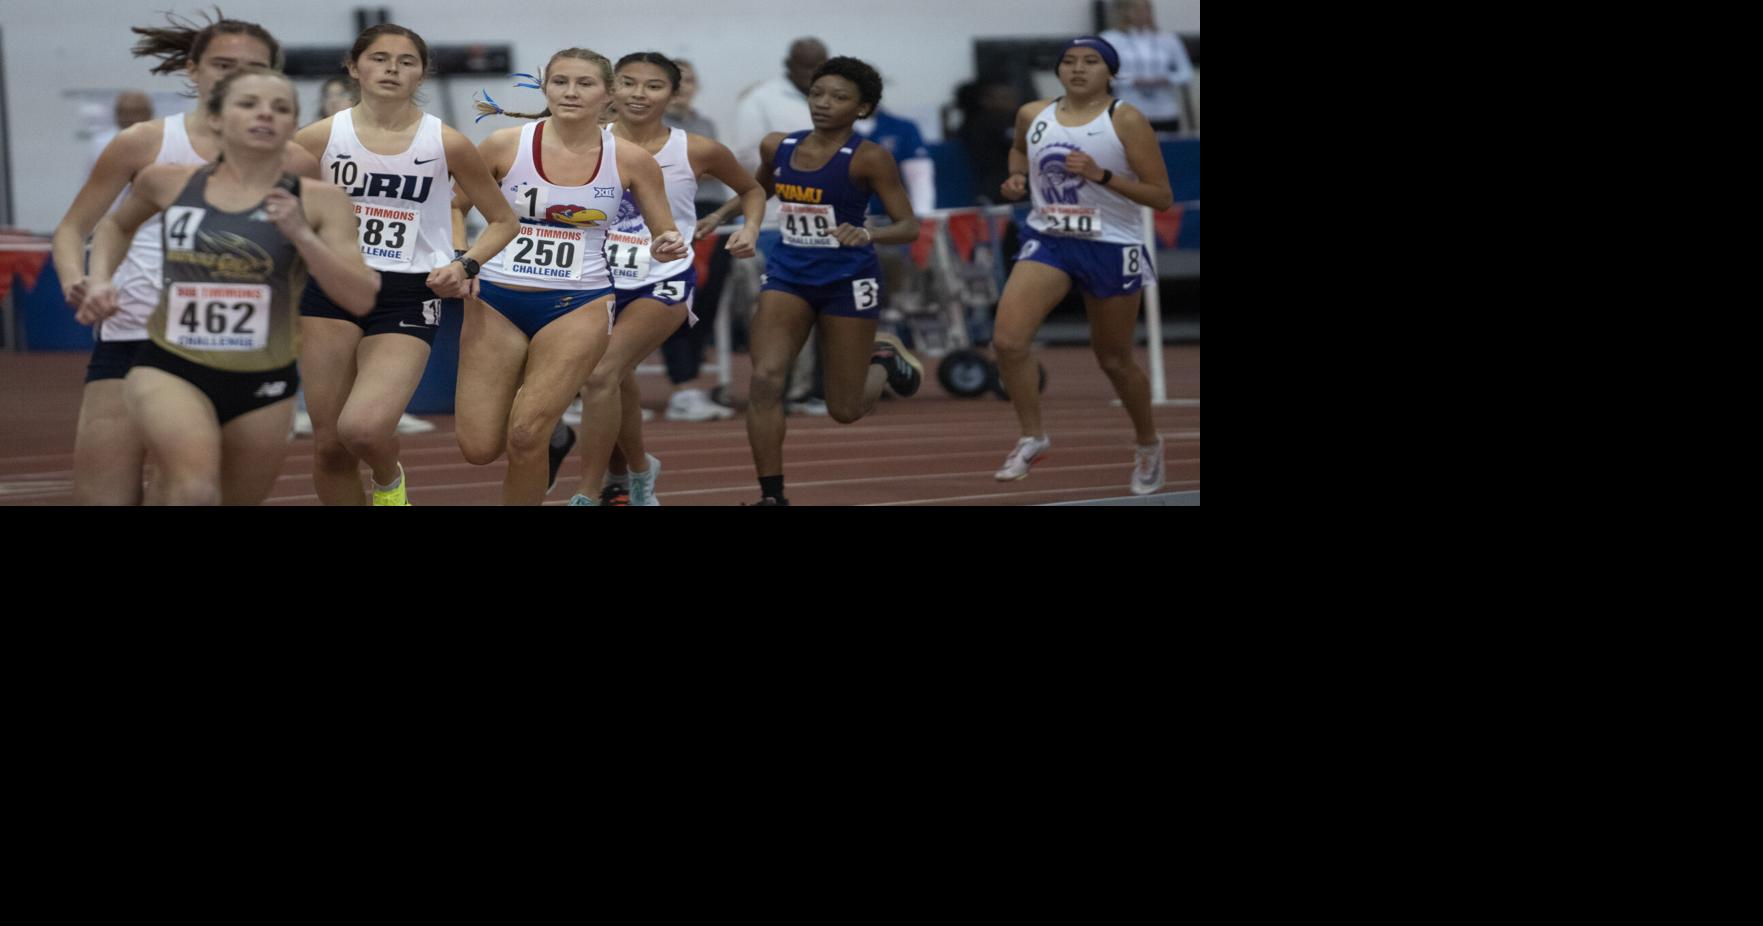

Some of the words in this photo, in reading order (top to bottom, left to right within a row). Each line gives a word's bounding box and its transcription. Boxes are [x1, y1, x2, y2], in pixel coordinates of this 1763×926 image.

[1030, 121, 1048, 145] 8
[330, 161, 358, 186] 10
[365, 207, 415, 221] TIMMONS
[524, 187, 538, 217] 1
[170, 210, 193, 246] 4
[520, 226, 533, 235] OB
[536, 228, 582, 241] TIMMONS
[785, 215, 829, 237] 419
[513, 237, 575, 268] 250
[1128, 248, 1140, 273] 8
[512, 264, 572, 278] CHALLENGE
[860, 281, 874, 307] 3
[179, 301, 255, 334] 462
